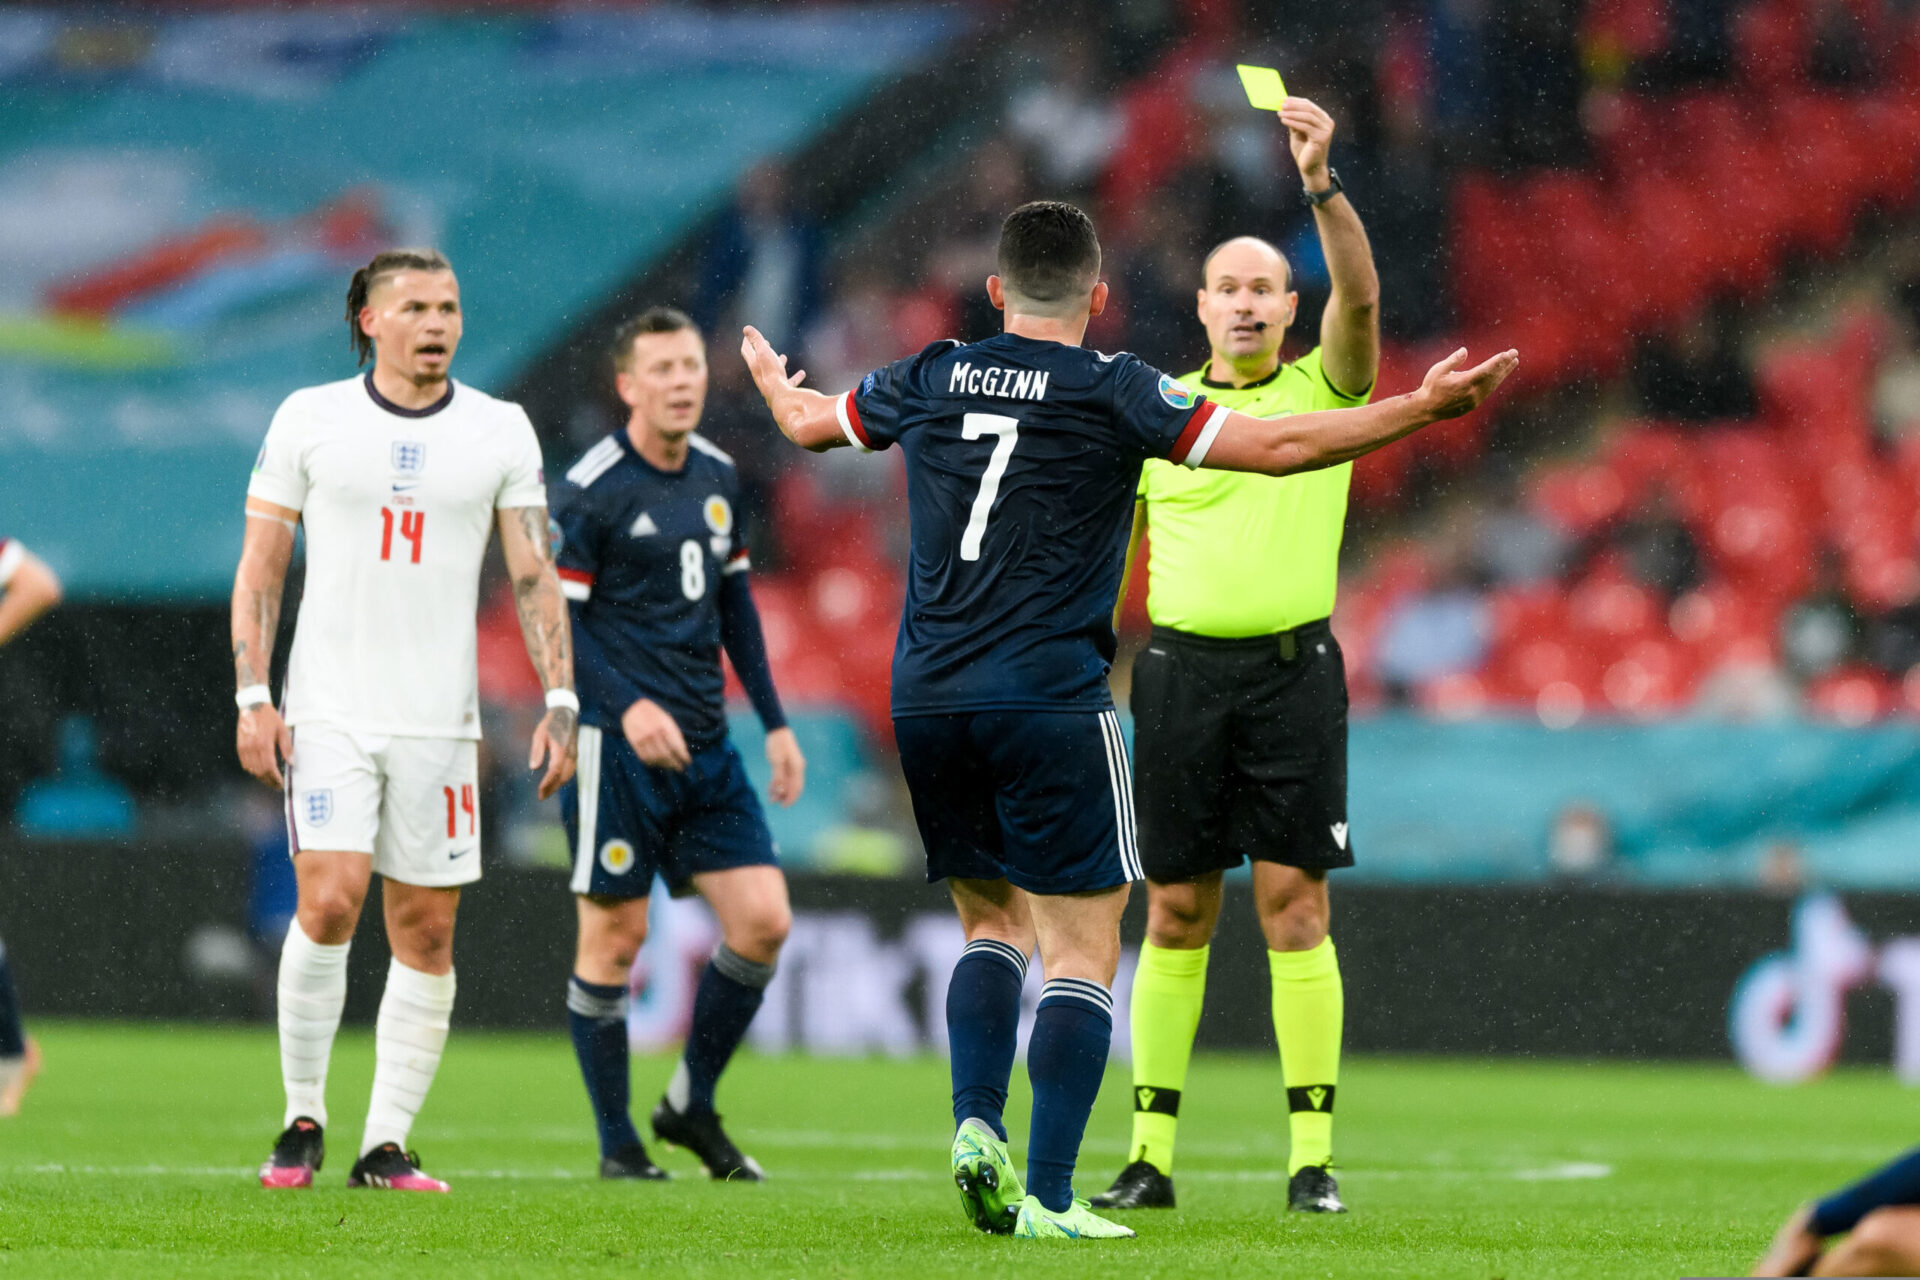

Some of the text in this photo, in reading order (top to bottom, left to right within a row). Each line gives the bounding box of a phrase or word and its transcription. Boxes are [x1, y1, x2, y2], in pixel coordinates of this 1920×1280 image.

[948, 361, 1050, 400] McGINN
[960, 412, 1019, 562] 7
[380, 505, 425, 564] 14
[680, 538, 706, 601] 8
[443, 783, 475, 839] 14
